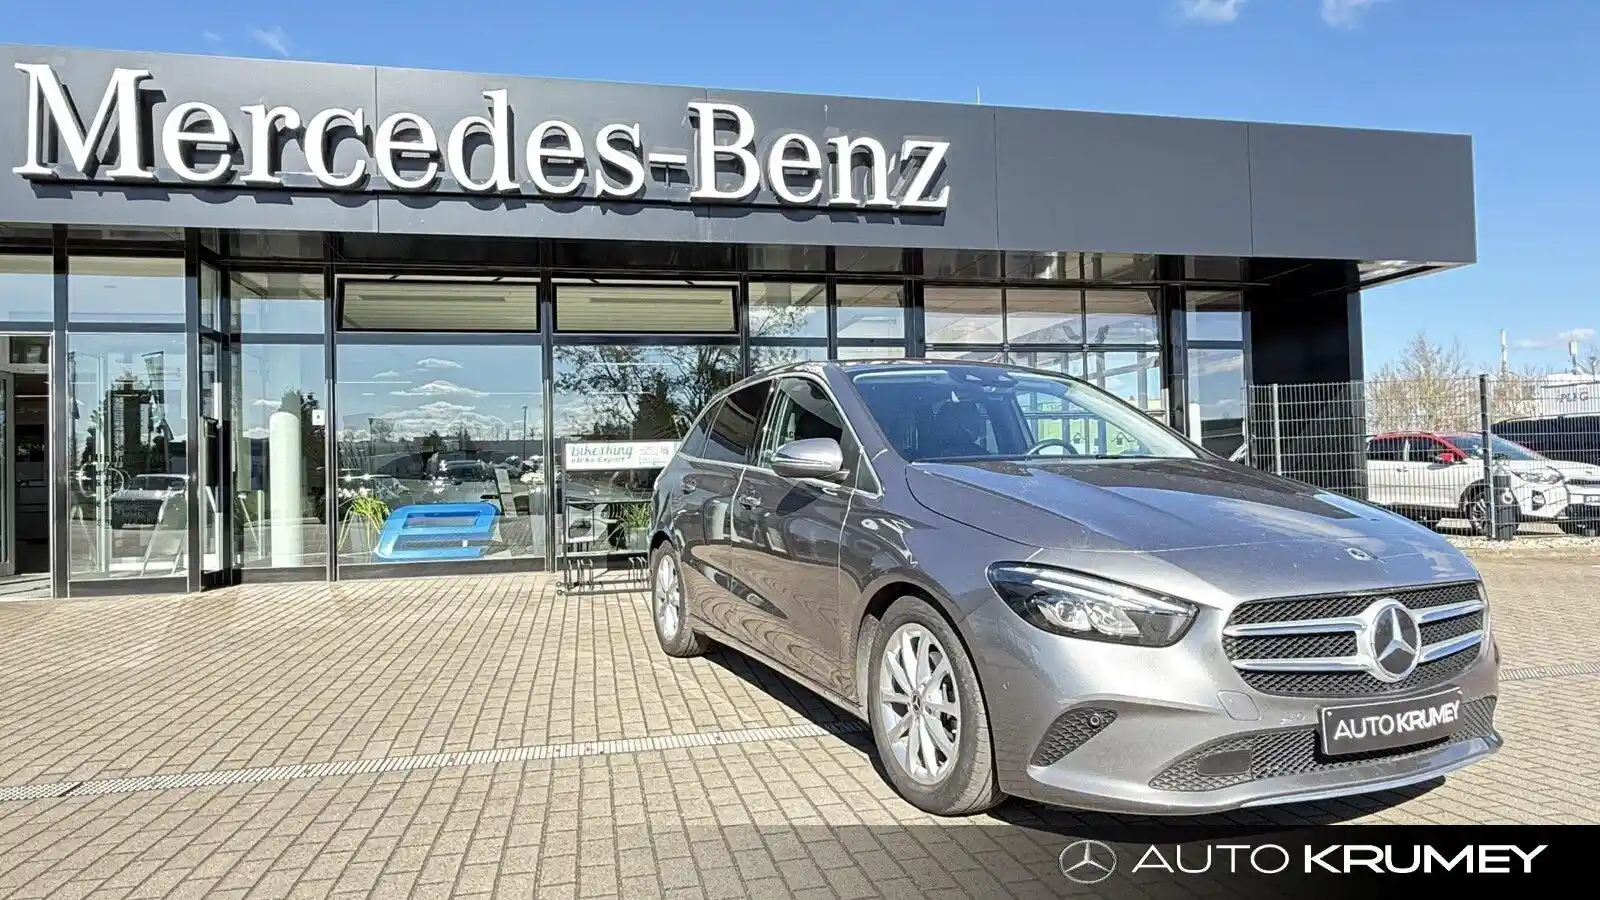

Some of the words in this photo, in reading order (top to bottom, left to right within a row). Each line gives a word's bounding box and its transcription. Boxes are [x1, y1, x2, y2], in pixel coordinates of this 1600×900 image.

[13, 62, 951, 210] Mercedes-Benz
[1333, 715, 1395, 741] AUTO
[1396, 700, 1461, 734] KRUMEY
